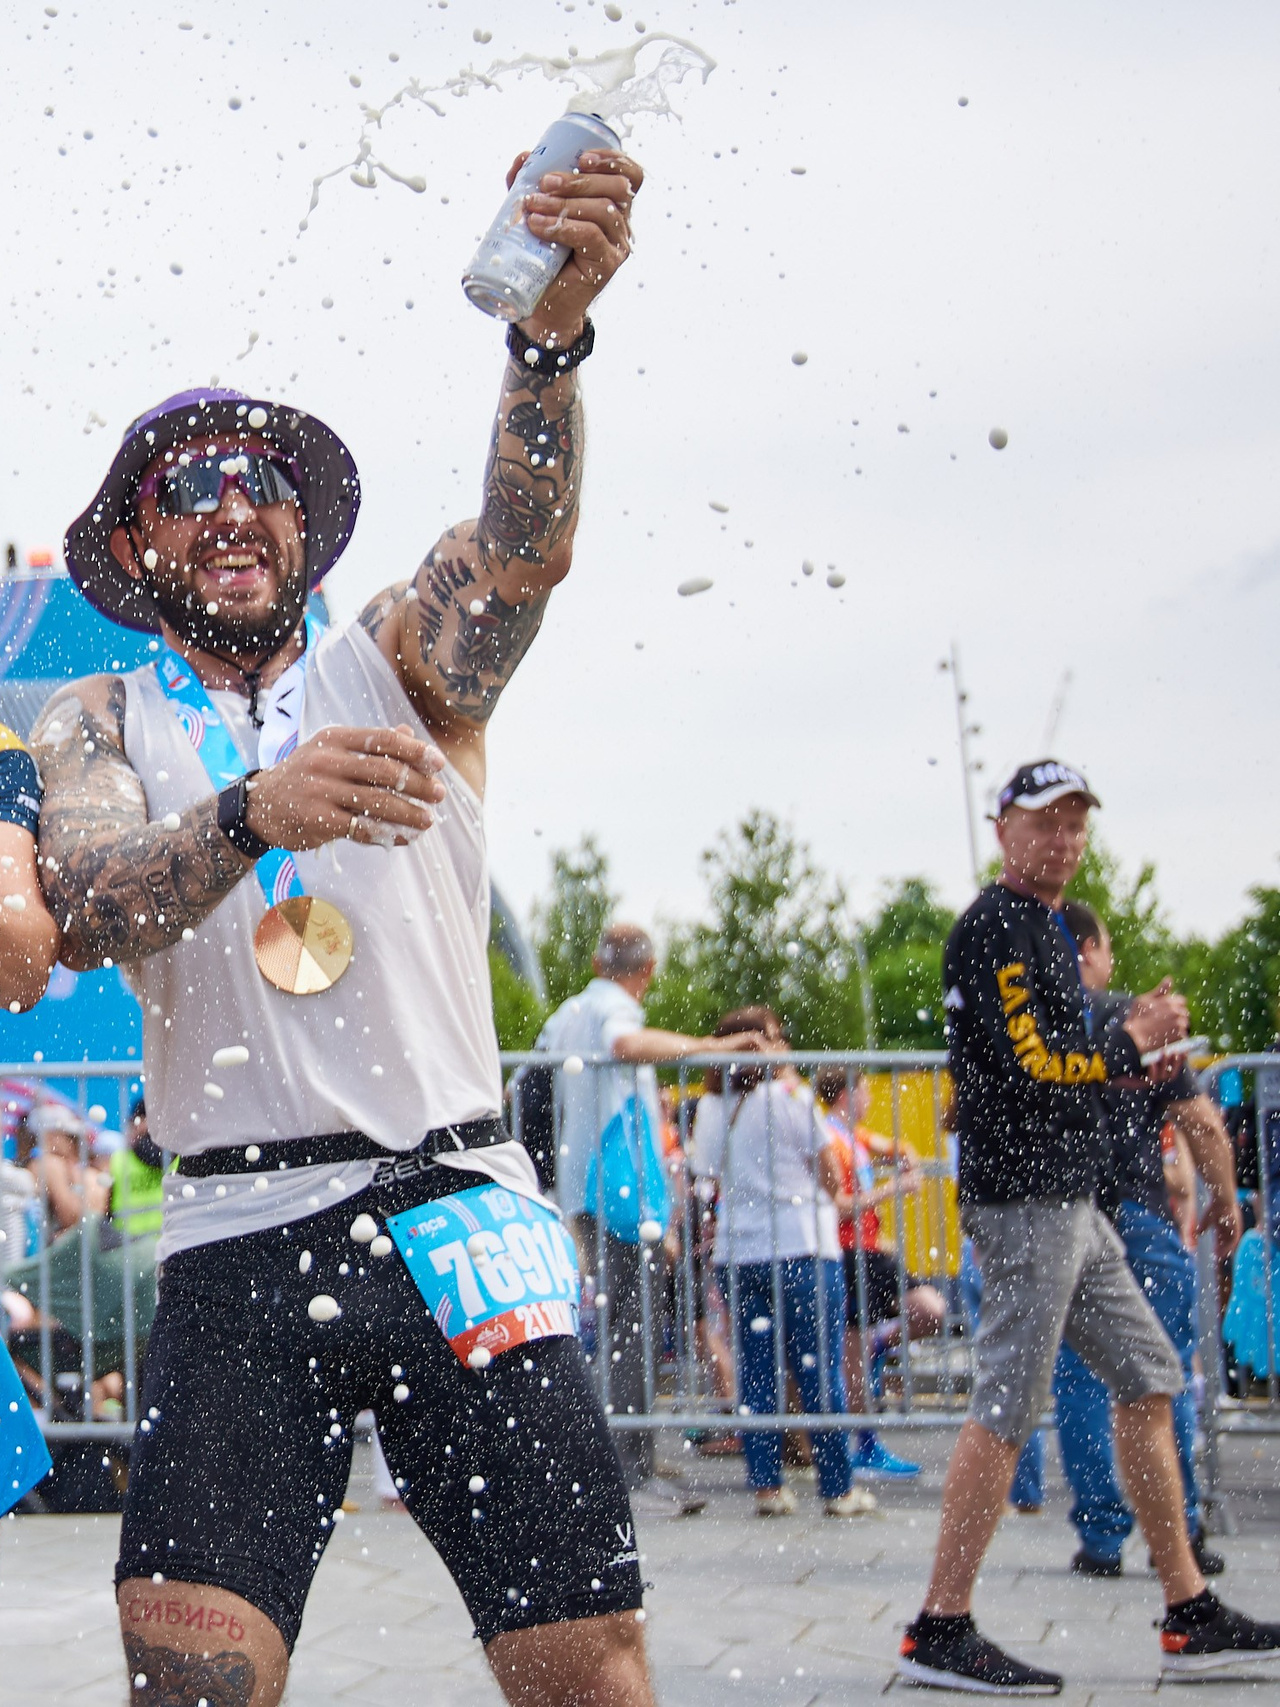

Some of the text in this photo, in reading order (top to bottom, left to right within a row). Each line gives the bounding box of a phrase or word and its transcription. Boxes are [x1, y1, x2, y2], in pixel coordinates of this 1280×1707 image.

[1006, 1012, 1108, 1085] STRADA
[419, 1215, 449, 1236] ПСБ
[427, 1220, 577, 1319] 76914
[608, 1550, 639, 1566] JÖGE
[128, 1598, 246, 1642] СИБИРЬ
